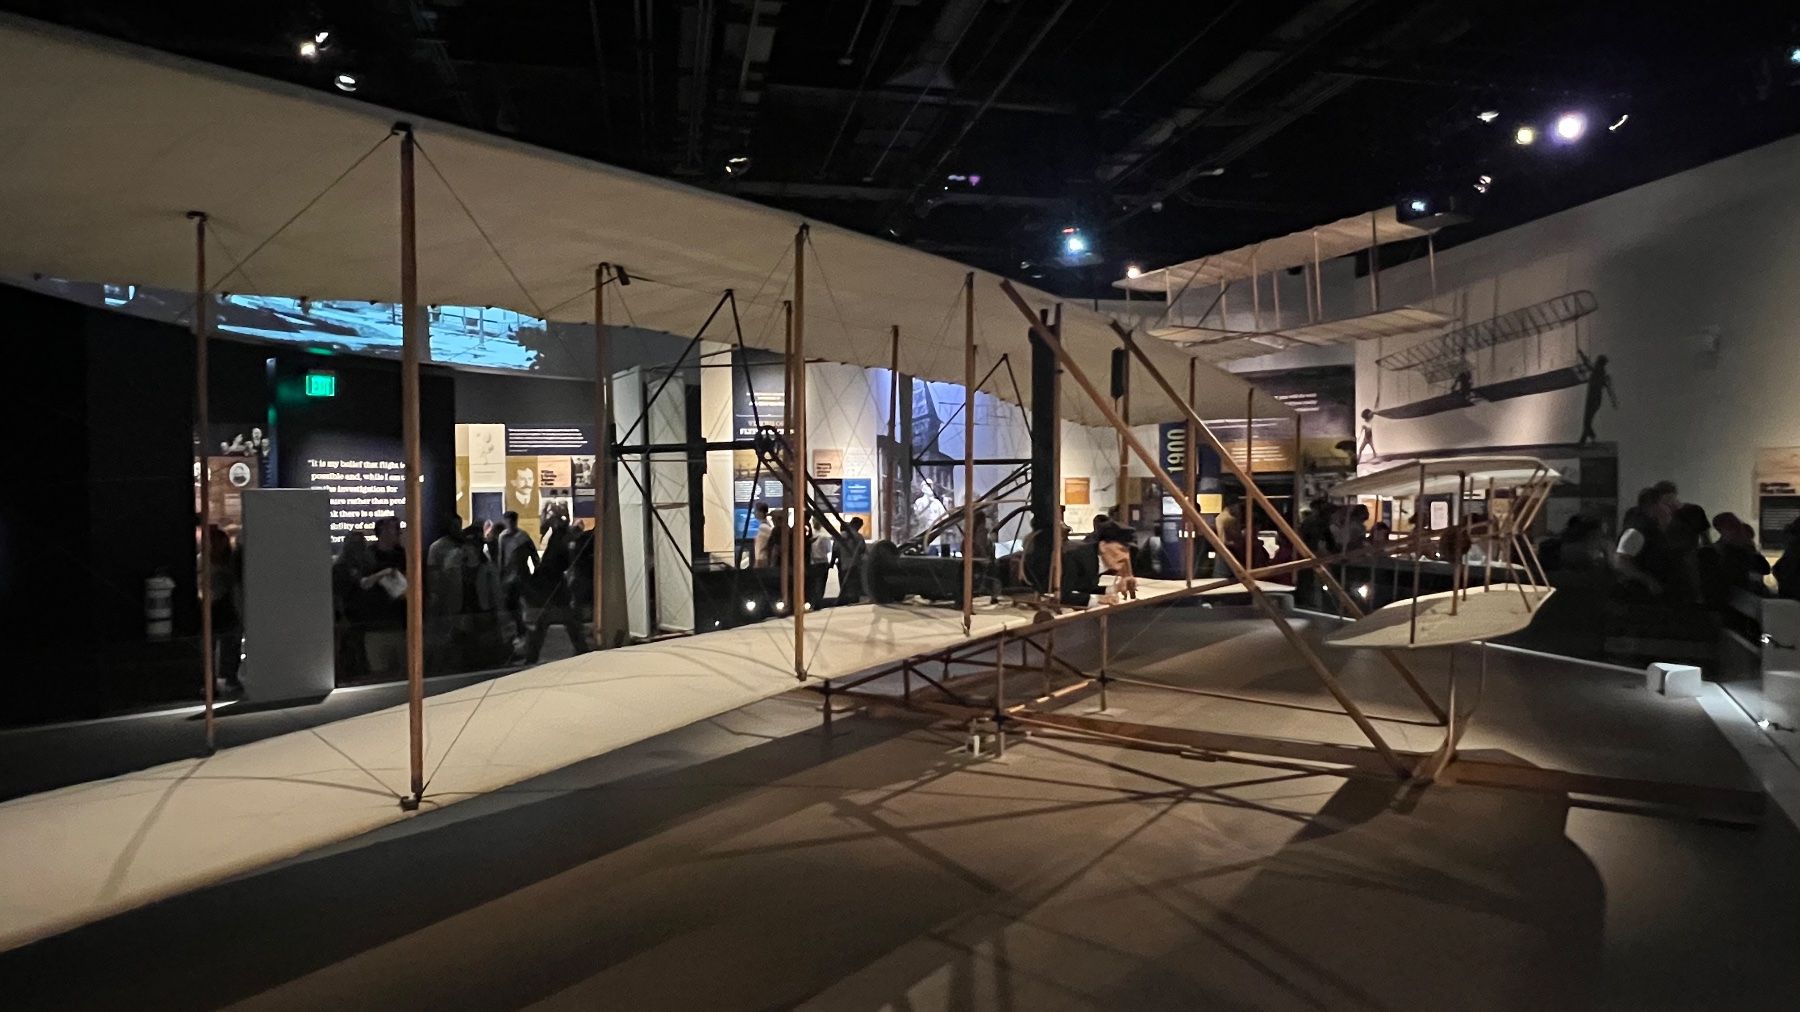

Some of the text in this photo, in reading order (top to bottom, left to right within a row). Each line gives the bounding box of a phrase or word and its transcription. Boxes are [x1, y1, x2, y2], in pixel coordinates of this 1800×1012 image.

[1167, 428, 1186, 474] 1900
[340, 460, 363, 469] belief
[363, 460, 379, 469] that
[311, 473, 344, 482] possible
[362, 473, 384, 481] while
[337, 486, 386, 494] investigation
[346, 497, 371, 505] rather
[371, 497, 389, 505] than
[339, 510, 360, 518] there
